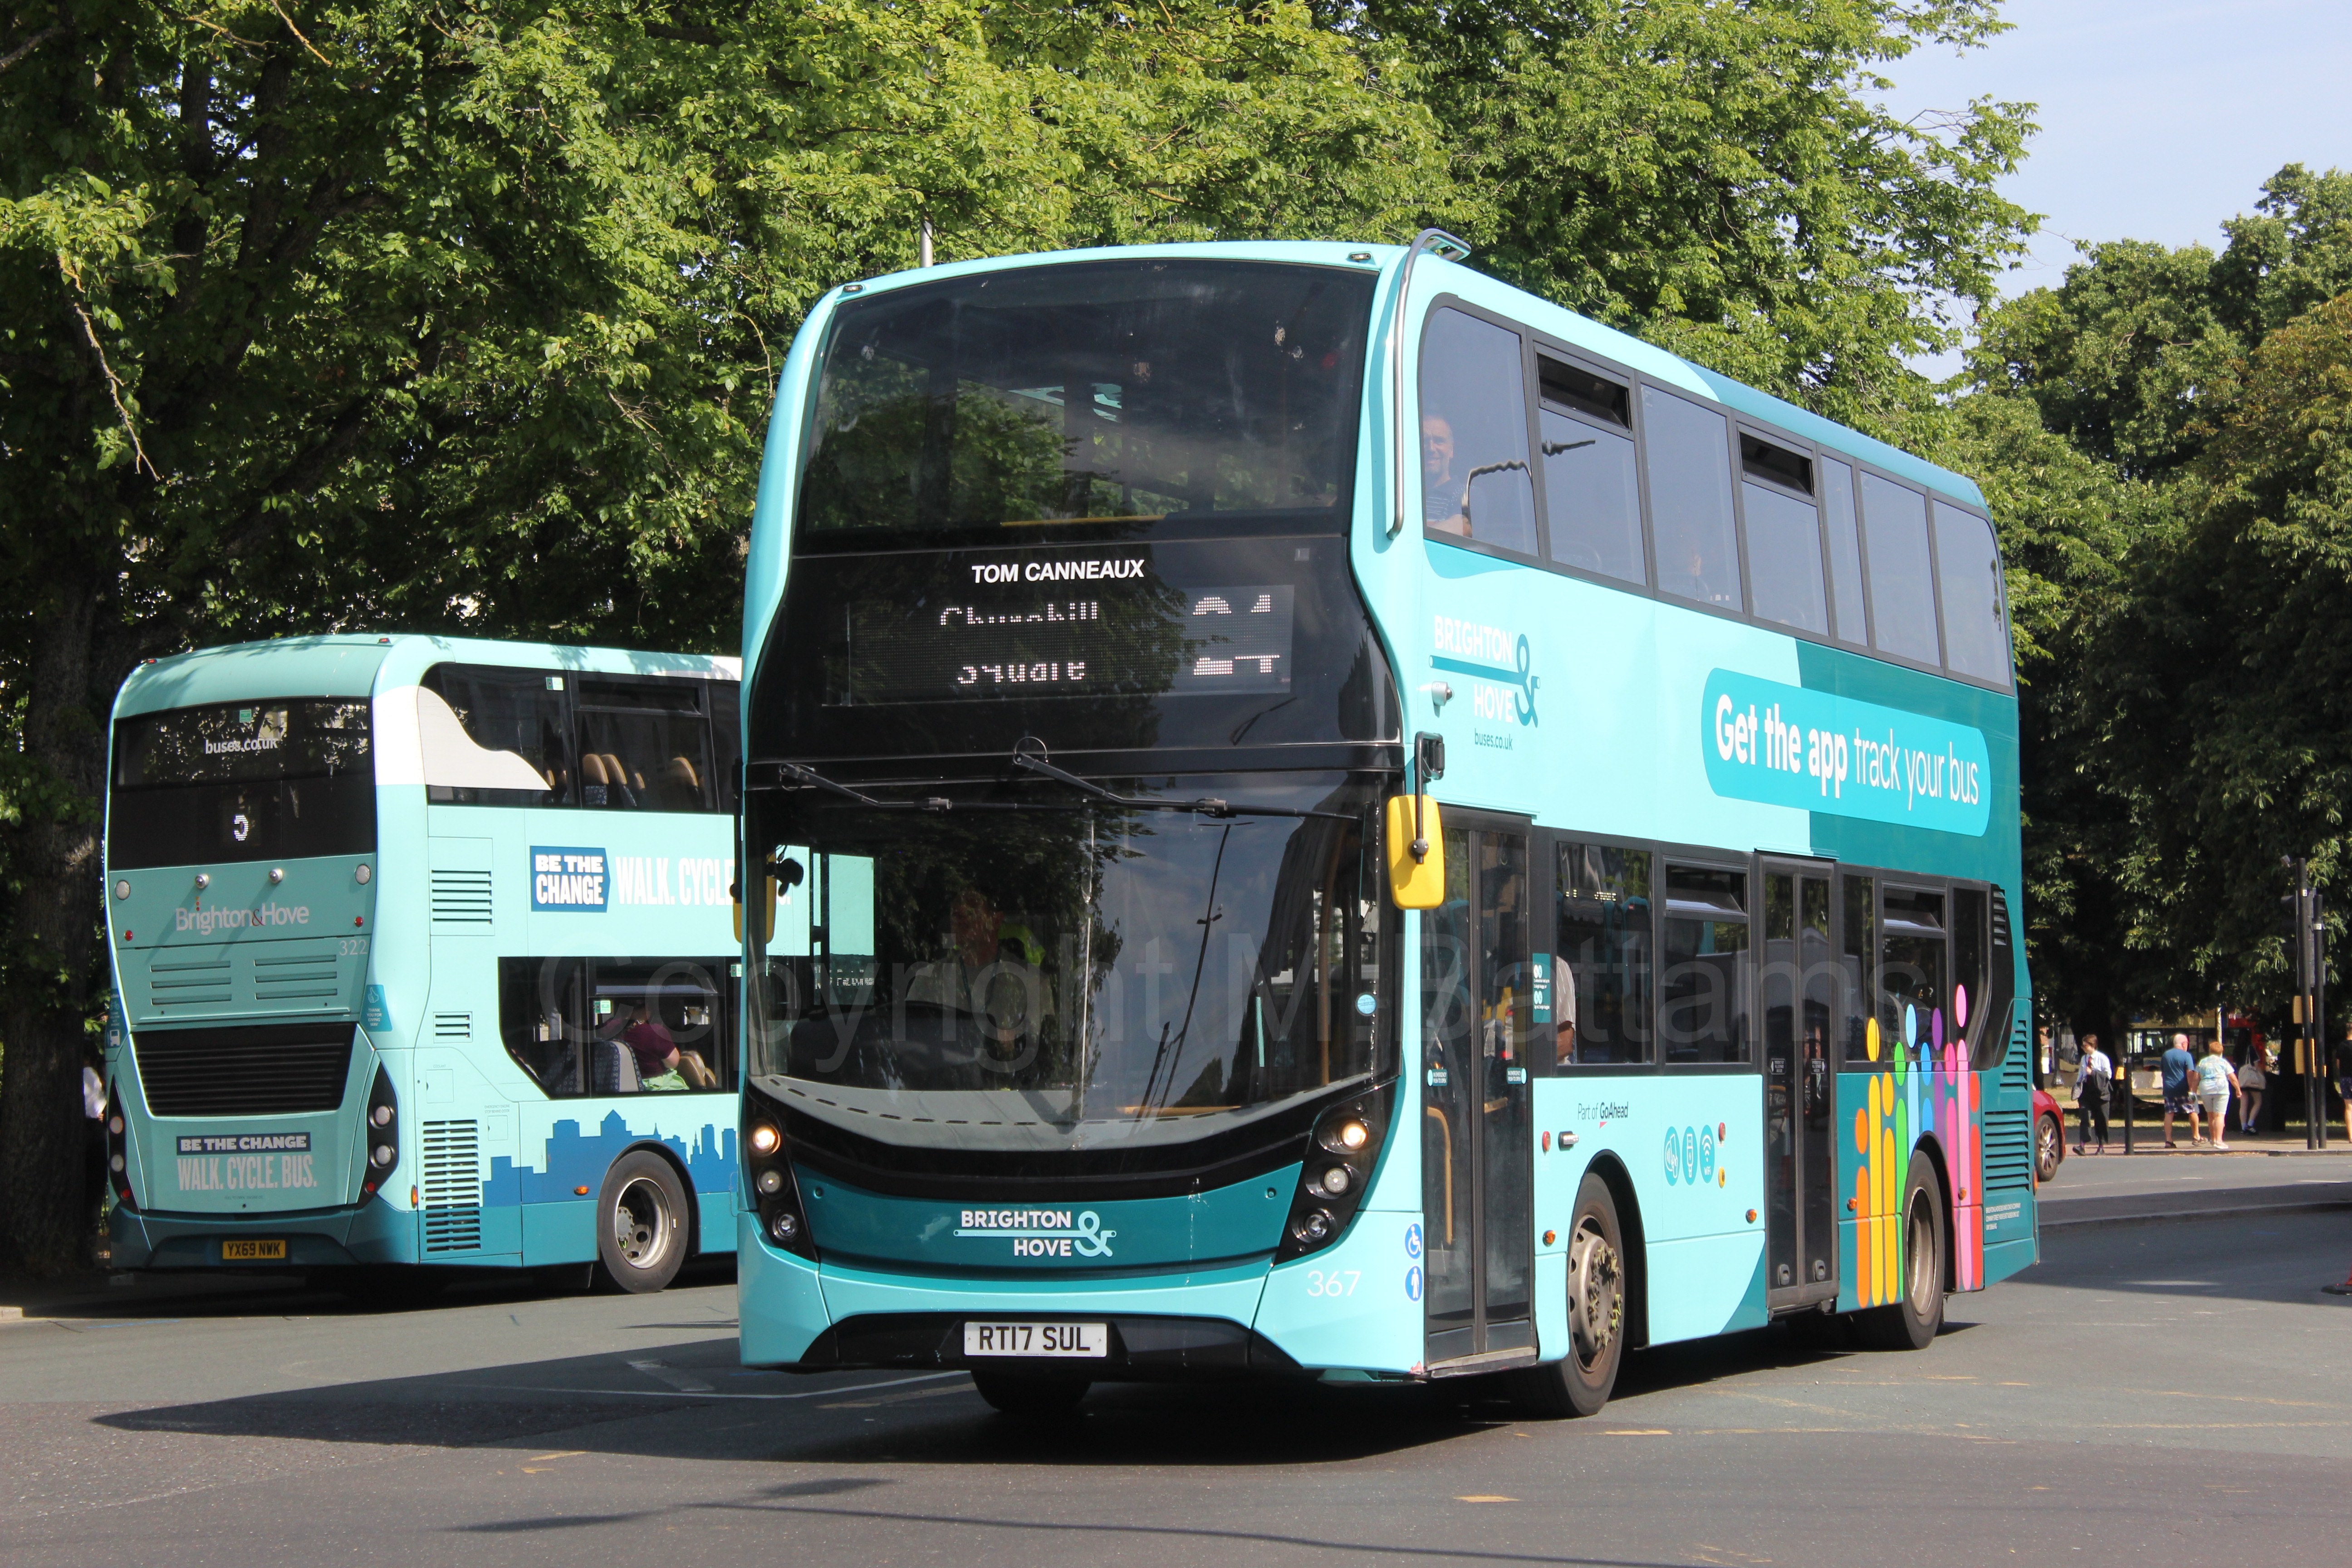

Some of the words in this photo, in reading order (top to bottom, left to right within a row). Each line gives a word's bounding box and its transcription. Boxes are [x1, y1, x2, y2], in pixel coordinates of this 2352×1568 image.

[971, 564, 1019, 583] TOM
[1024, 559, 1145, 582] CANNEAUX
[1434, 614, 1513, 664] BRIGHTON
[1474, 683, 1514, 723] HOVE
[205, 738, 278, 755] buses.co.uk
[1475, 727, 1514, 751] buses.co.uk
[1715, 694, 1758, 766] Get
[1764, 703, 1802, 774] the
[1808, 728, 1848, 799] app
[1854, 727, 1901, 791] track
[1905, 748, 1945, 812] your
[1949, 741, 1979, 805] bus
[534, 854, 562, 872] BE
[564, 855, 604, 873] THE
[535, 874, 604, 905] CHANGE
[615, 856, 676, 905] WALK.
[339, 939, 368, 956] 322
[1578, 1102, 1590, 1121] Part
[1592, 1102, 1598, 1120] of
[1600, 1101, 1628, 1120] GoAhead
[180, 1139, 201, 1152] BE
[204, 1138, 237, 1151] THE
[239, 1136, 307, 1150] CHANGE
[177, 1157, 224, 1191] WALK.
[227, 1156, 278, 1190] CYCLE.
[281, 1154, 318, 1188] BUS.
[961, 1210, 1072, 1228] BRIGHTON
[227, 1242, 256, 1257] YX69
[258, 1242, 280, 1256] NWK
[1014, 1239, 1072, 1257] HOVE
[1306, 1270, 1362, 1297] 367
[979, 1326, 1034, 1351] RT17
[1043, 1326, 1091, 1352] SUL
